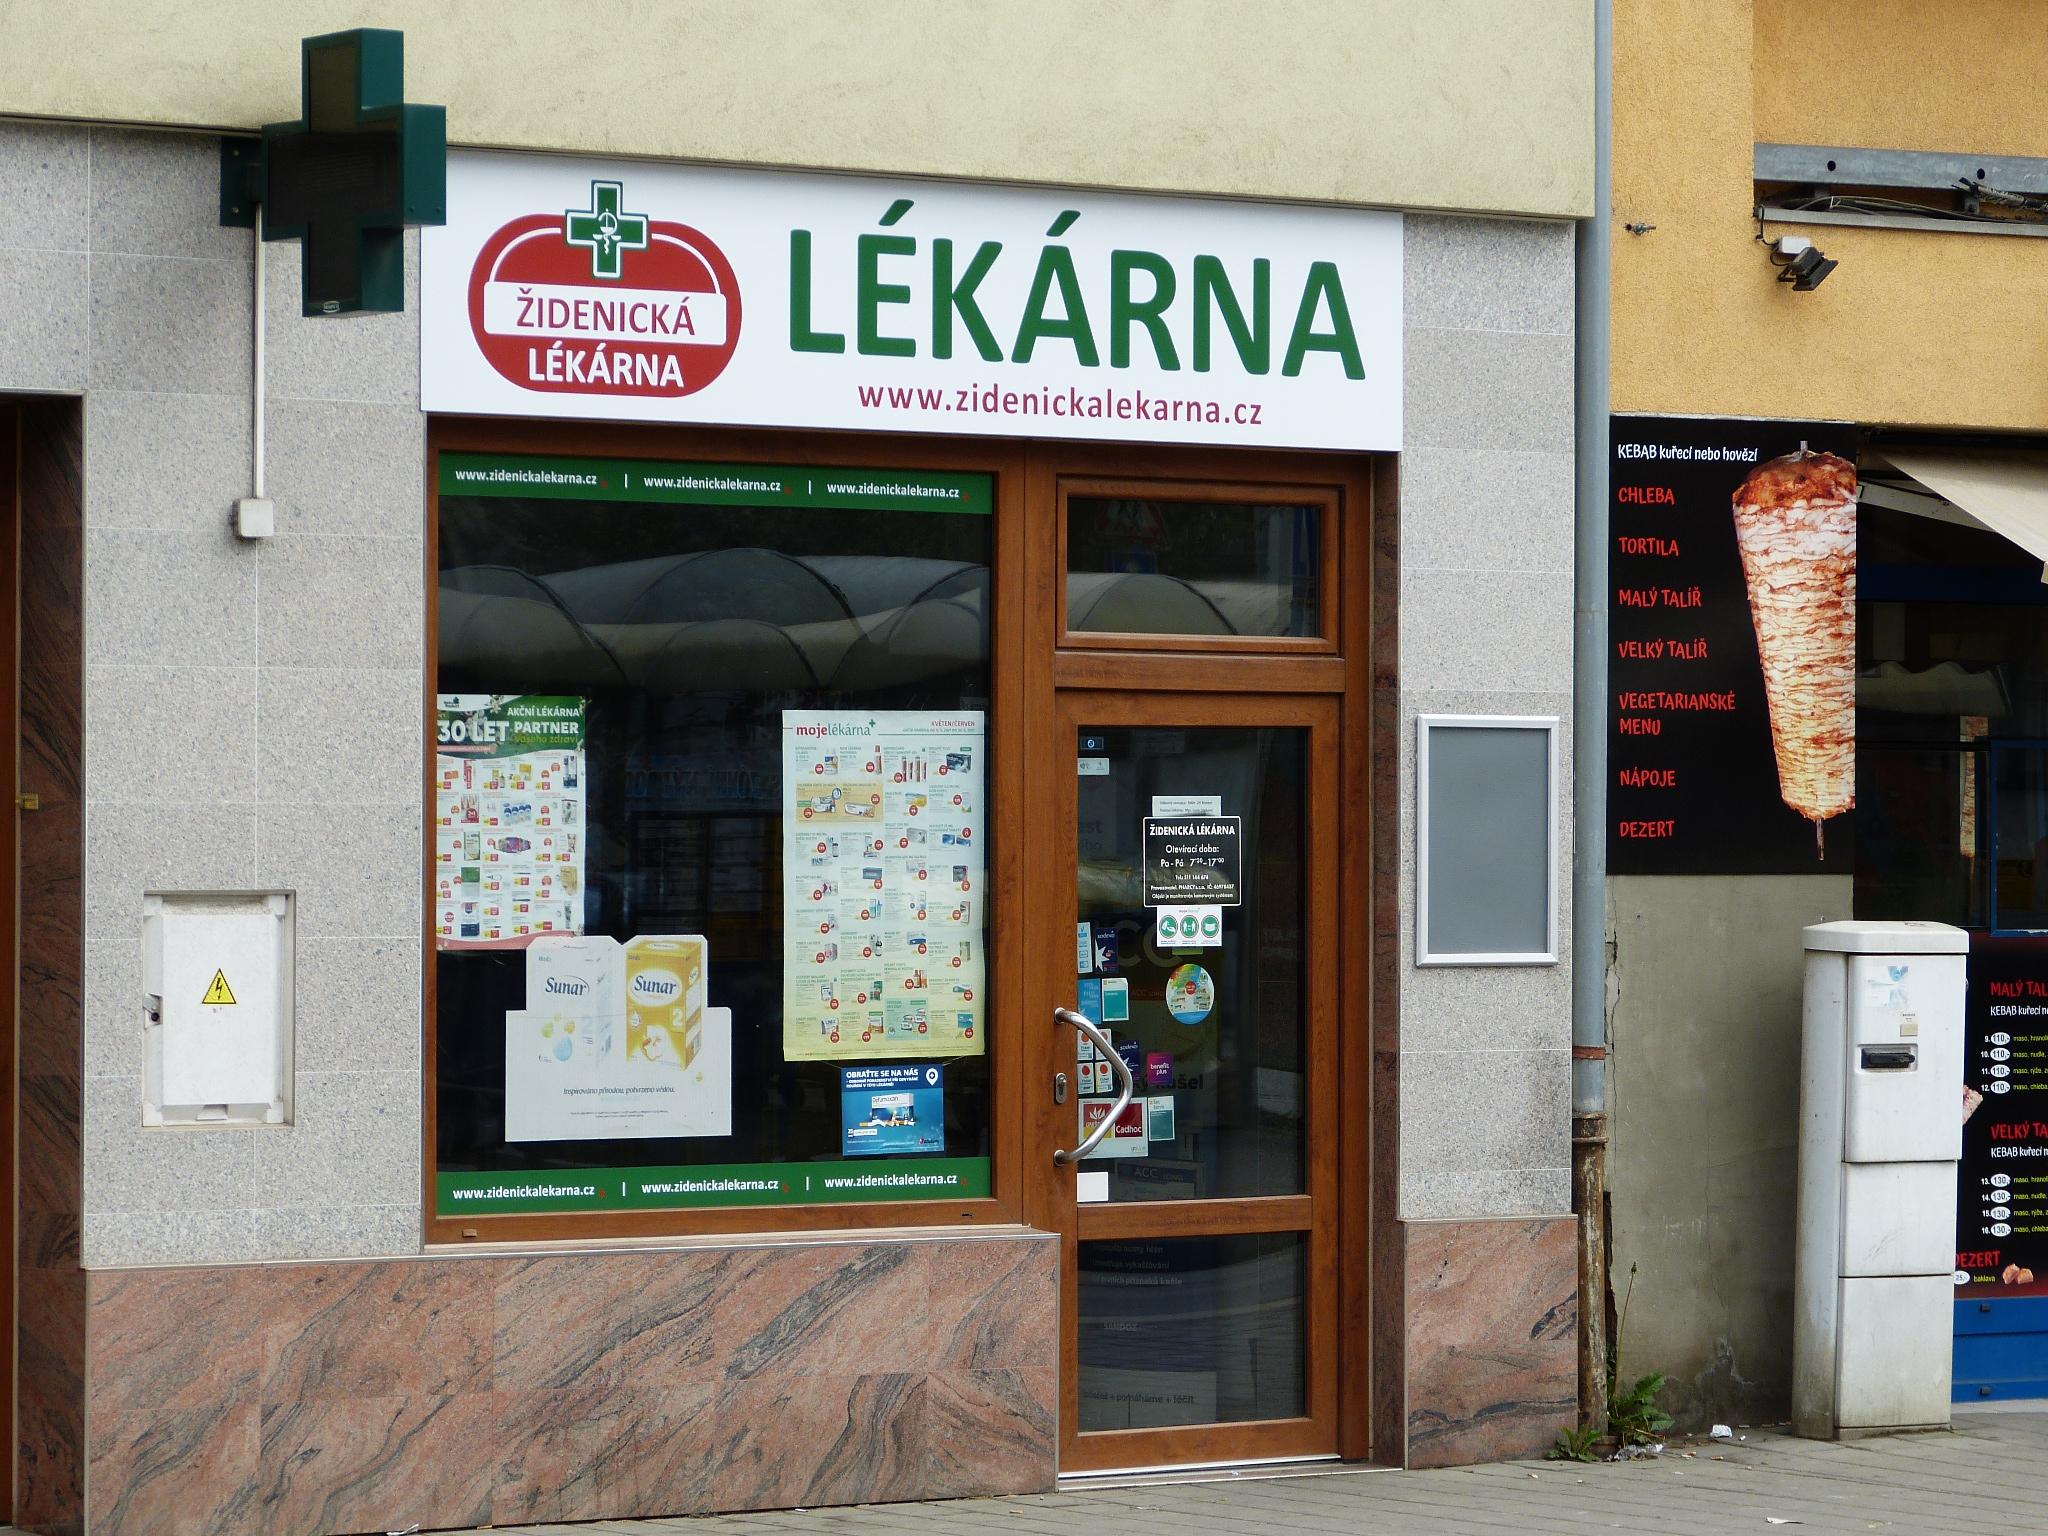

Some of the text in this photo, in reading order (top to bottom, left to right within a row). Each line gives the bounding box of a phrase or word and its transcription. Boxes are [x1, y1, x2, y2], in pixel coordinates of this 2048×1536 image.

[789, 198, 1366, 380] LÉKÁRNA
[516, 287, 696, 336] ŽIDENICKÁ
[528, 340, 685, 388] LÉKÁRNA
[858, 383, 1262, 425] www.zidenickalekarna.cz
[1618, 444, 1758, 462] KEBAB kuřecí nebo hovězí
[455, 468, 959, 498] www.zidenickalekarna.cz www.zidenickalekarna.cz www.zidenickalekarna.cz
[1618, 487, 1675, 505] CHLEBA
[1618, 537, 1680, 557] TORTILA
[1619, 586, 1702, 608] MALÝ TALÍŘ
[1618, 638, 1708, 660] VELKÝ TALÍŘ
[1618, 690, 1736, 711] VEGETARIANSKÉ
[507, 704, 580, 717] AKČNÍ LÉKÁRNA
[437, 719, 510, 742] 30 LET
[514, 721, 579, 734] PARTNER
[796, 721, 871, 739] mojelékárna
[1619, 718, 1661, 736] MENU
[1620, 766, 1676, 787] NÁPOJE
[1149, 822, 1236, 836] ŽIDENICKÁ LÉKÁRNA
[1620, 821, 1675, 838] DEZERT
[1165, 843, 1220, 854] Otevírací doba:
[1160, 858, 1170, 868] Po
[1174, 858, 1184, 868] Pá
[545, 975, 677, 996] Sunar Sunar
[1990, 979, 2023, 997] MALÝ
[1990, 1005, 2017, 1017] KEBAB
[2018, 1004, 2041, 1016] kuřecí
[1992, 1034, 2010, 1042] 110,-
[1992, 1050, 2010, 1059] 110,-
[846, 1068, 919, 1079] OBRAŤTE SE NA NÁS
[1150, 1062, 1170, 1070] benefit
[1992, 1067, 2010, 1075] 110,-
[1992, 1083, 2010, 1092] 110,-
[1115, 1124, 1142, 1134] Cadhoc
[1990, 1120, 2030, 1140] VELKÝ
[1990, 1146, 2018, 1158] KEBAB
[2019, 1145, 2043, 1157] kuřecí
[453, 1173, 958, 1200] www.zidenickalekarna.cz www.zidenickalekarna.cz www.zidenickalekarna.cz
[1993, 1176, 2011, 1186] 130,-
[1993, 1192, 2011, 1201] 130,-
[1993, 1209, 2011, 1218] 130,-
[1993, 1225, 2011, 1234] 130,-
[1973, 1274, 1996, 1283] baklava
